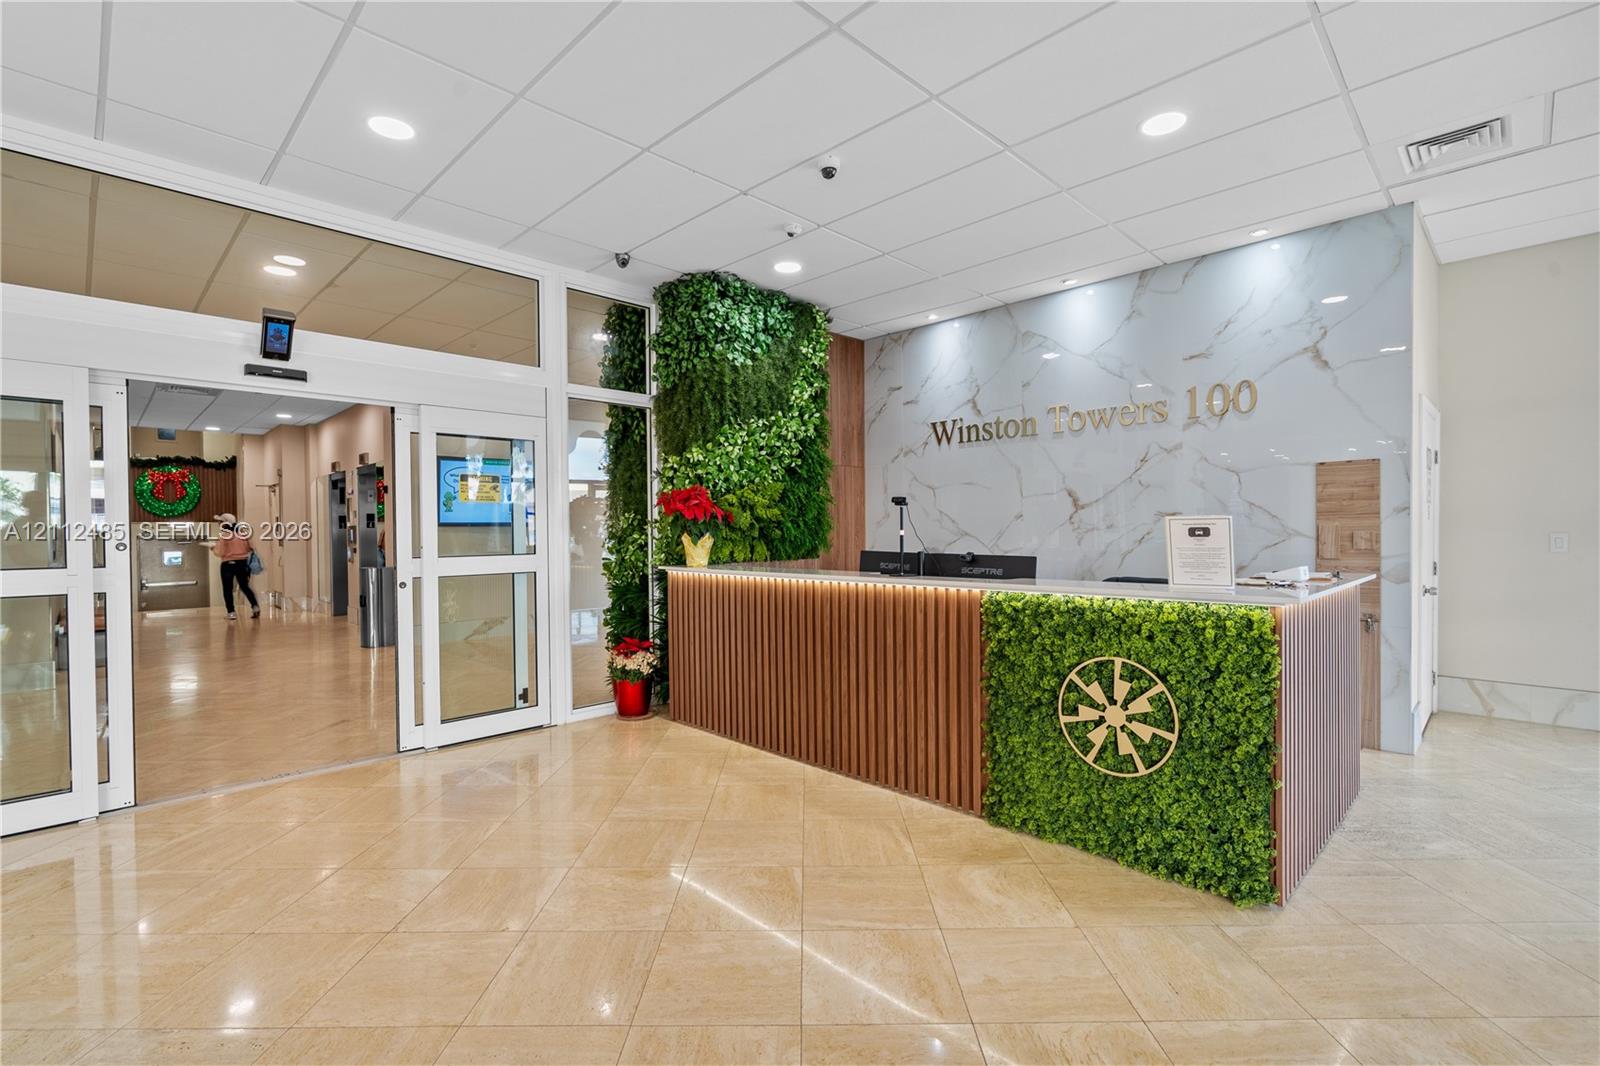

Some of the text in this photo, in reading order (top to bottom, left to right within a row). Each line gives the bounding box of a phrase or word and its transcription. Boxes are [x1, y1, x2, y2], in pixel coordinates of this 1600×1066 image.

[930, 379, 1258, 447] Winston Towers 100
[961, 567, 1003, 576] SCEPTRE
